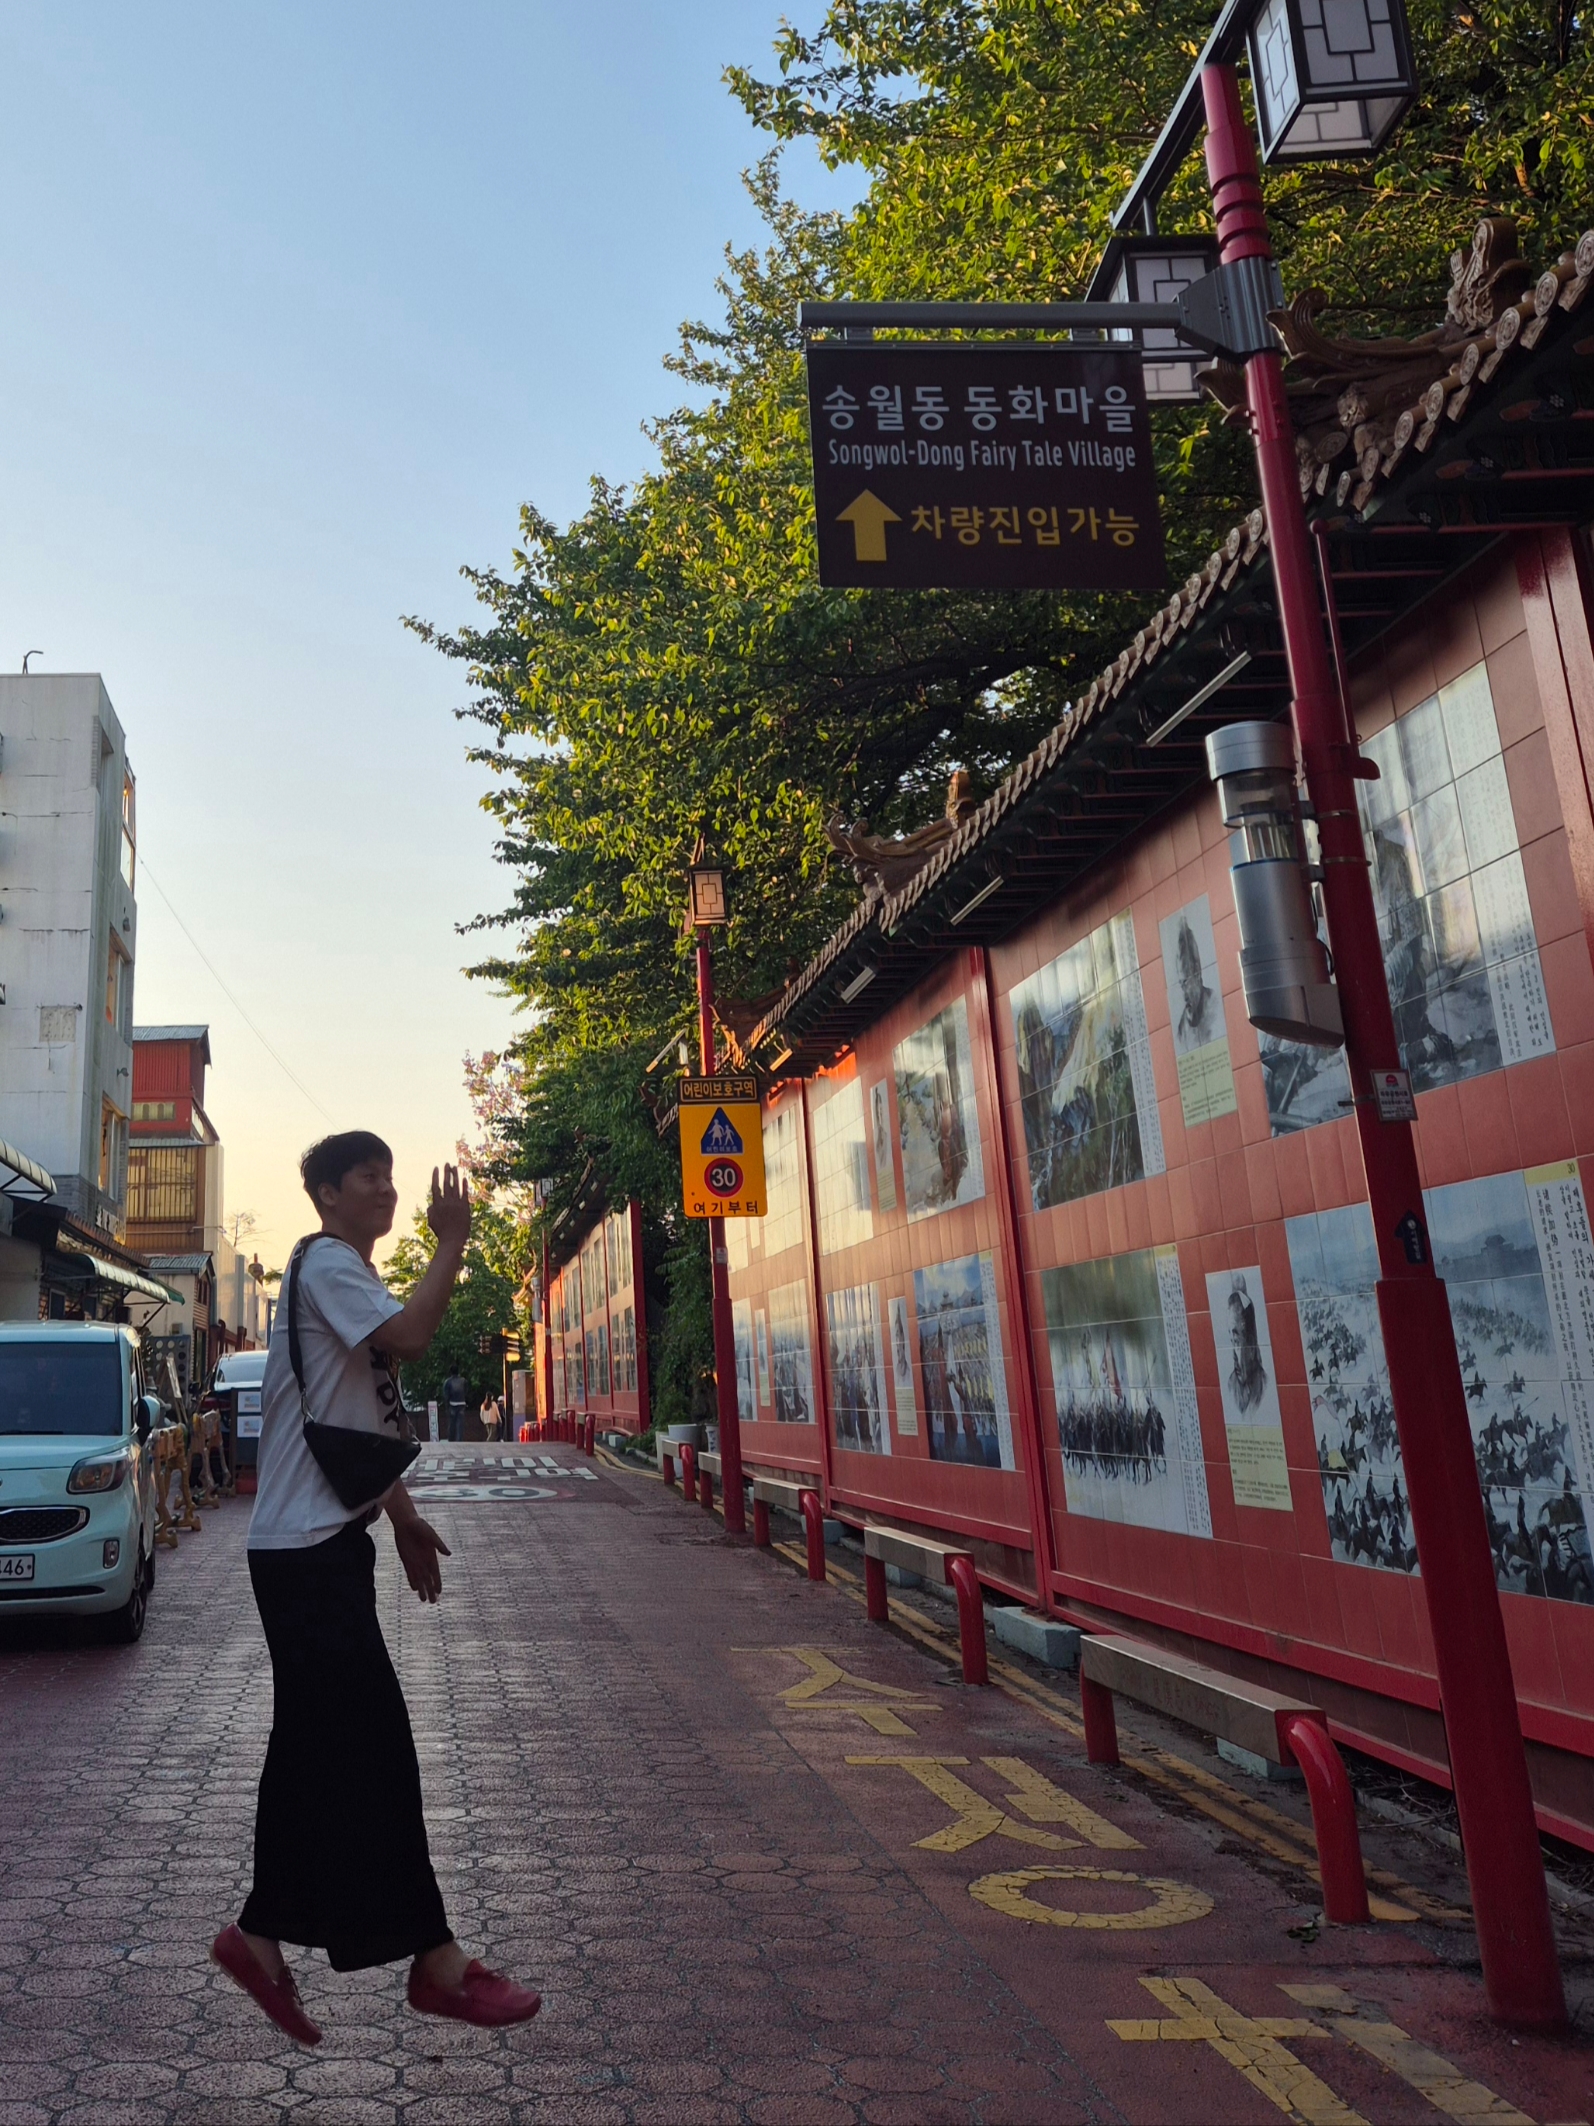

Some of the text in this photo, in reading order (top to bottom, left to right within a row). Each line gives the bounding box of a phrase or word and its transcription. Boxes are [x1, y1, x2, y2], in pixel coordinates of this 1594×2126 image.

[822, 384, 1136, 433] 송월동 동화마을
[828, 438, 1136, 472] Songwol-Dong Fairy Tale Village
[910, 504, 1140, 547] 차량진입가능
[711, 1167, 737, 1188] 30
[0, 1558, 25, 1577] 46
